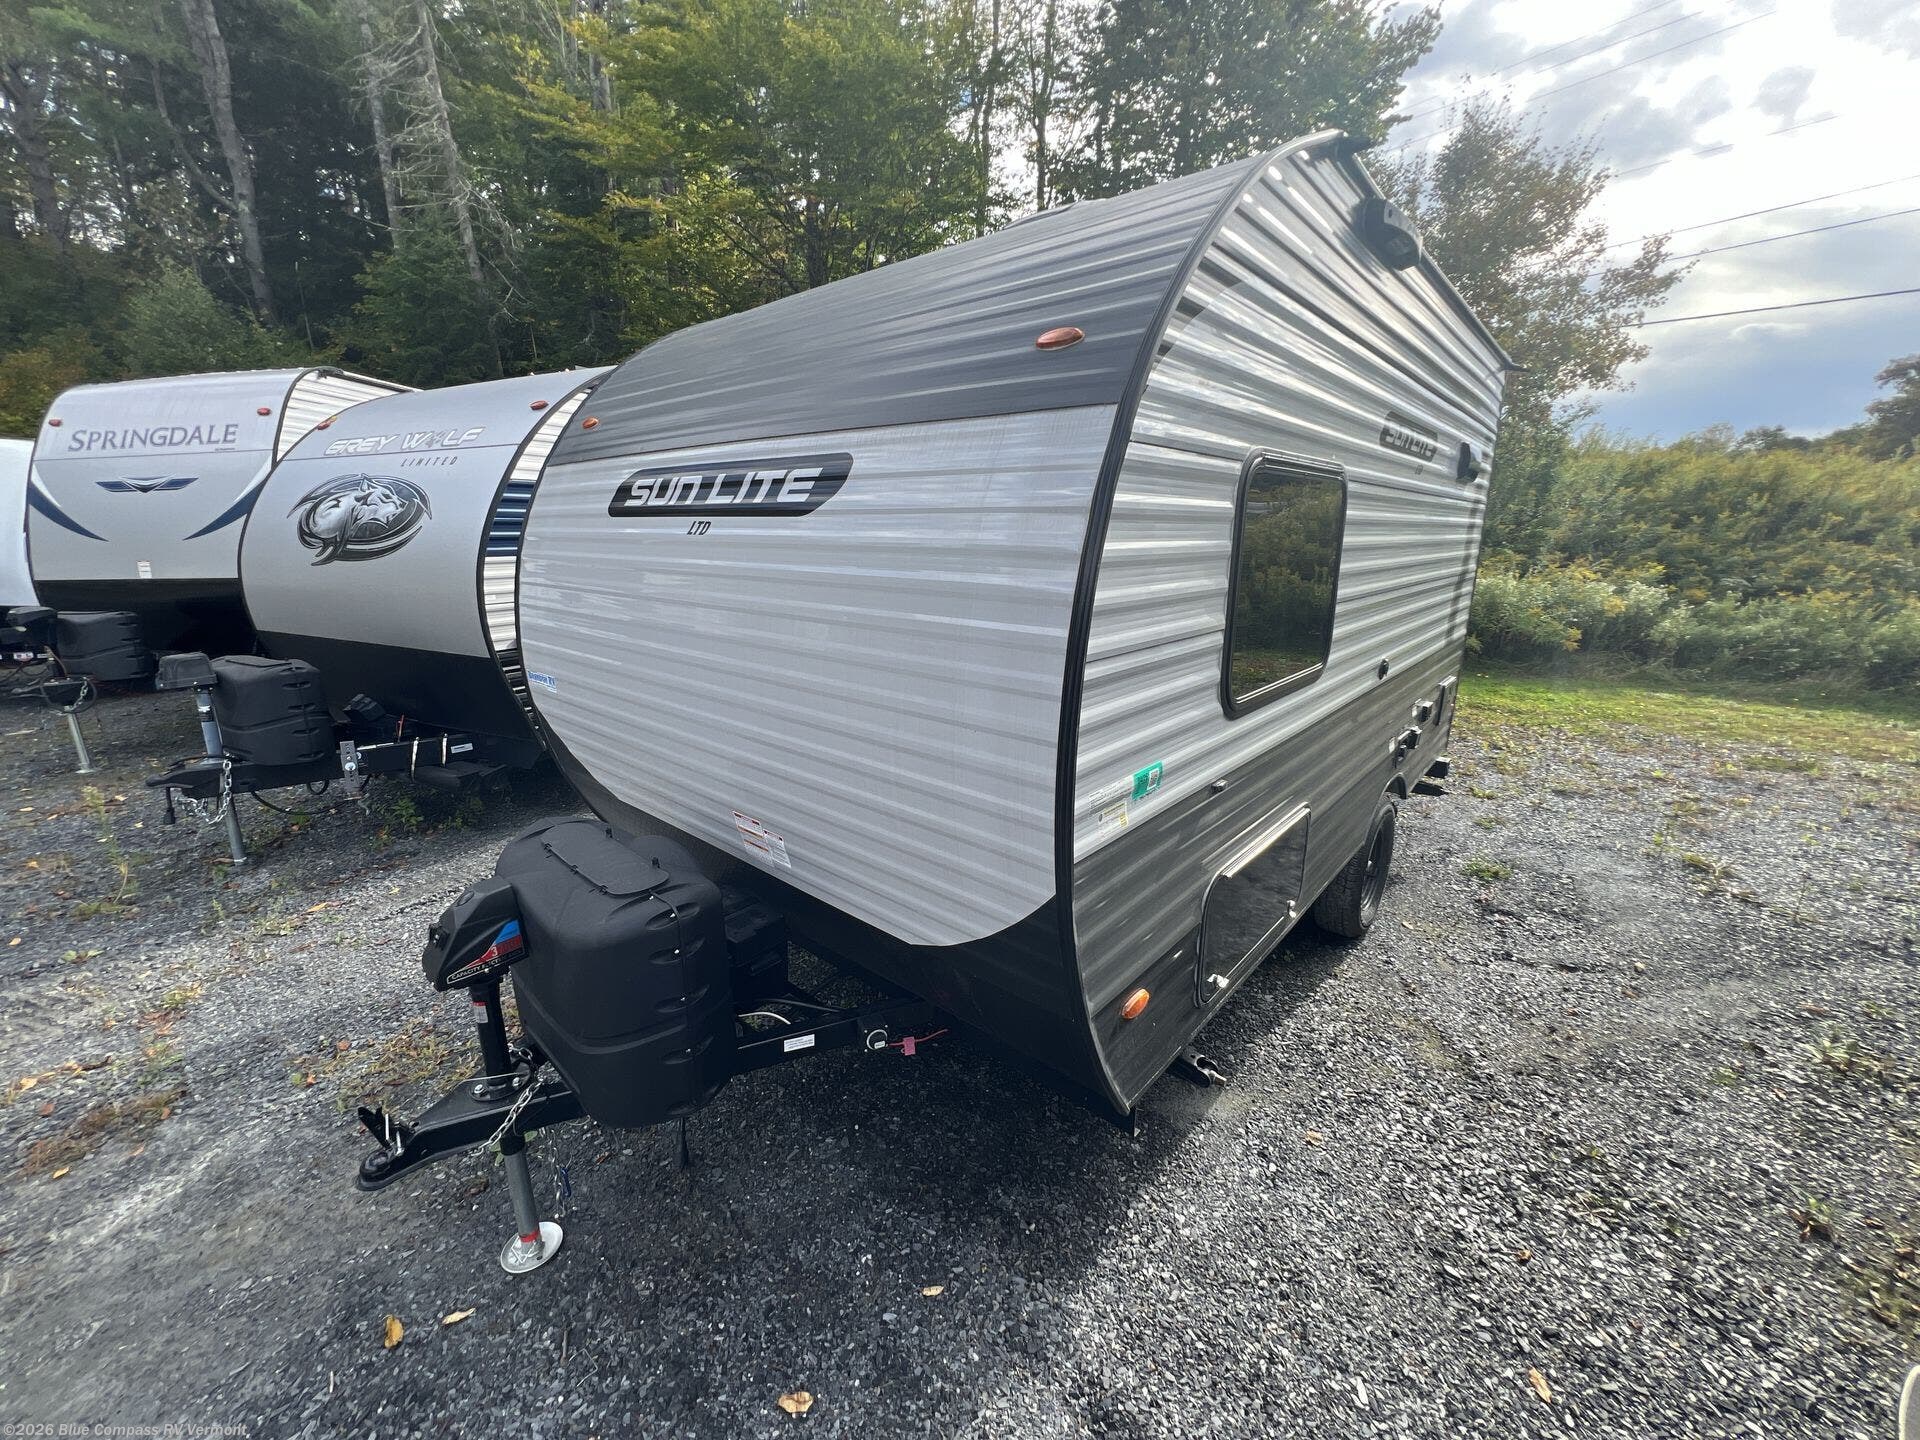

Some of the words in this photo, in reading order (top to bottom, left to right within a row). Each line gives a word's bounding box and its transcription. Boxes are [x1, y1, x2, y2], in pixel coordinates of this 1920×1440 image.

[67, 424, 238, 452] SPRINGDALE
[324, 433, 399, 455] GREY
[401, 456, 458, 467] LIMITED
[624, 475, 702, 507] SUN
[705, 467, 823, 504] LITE
[686, 520, 712, 536] LTD
